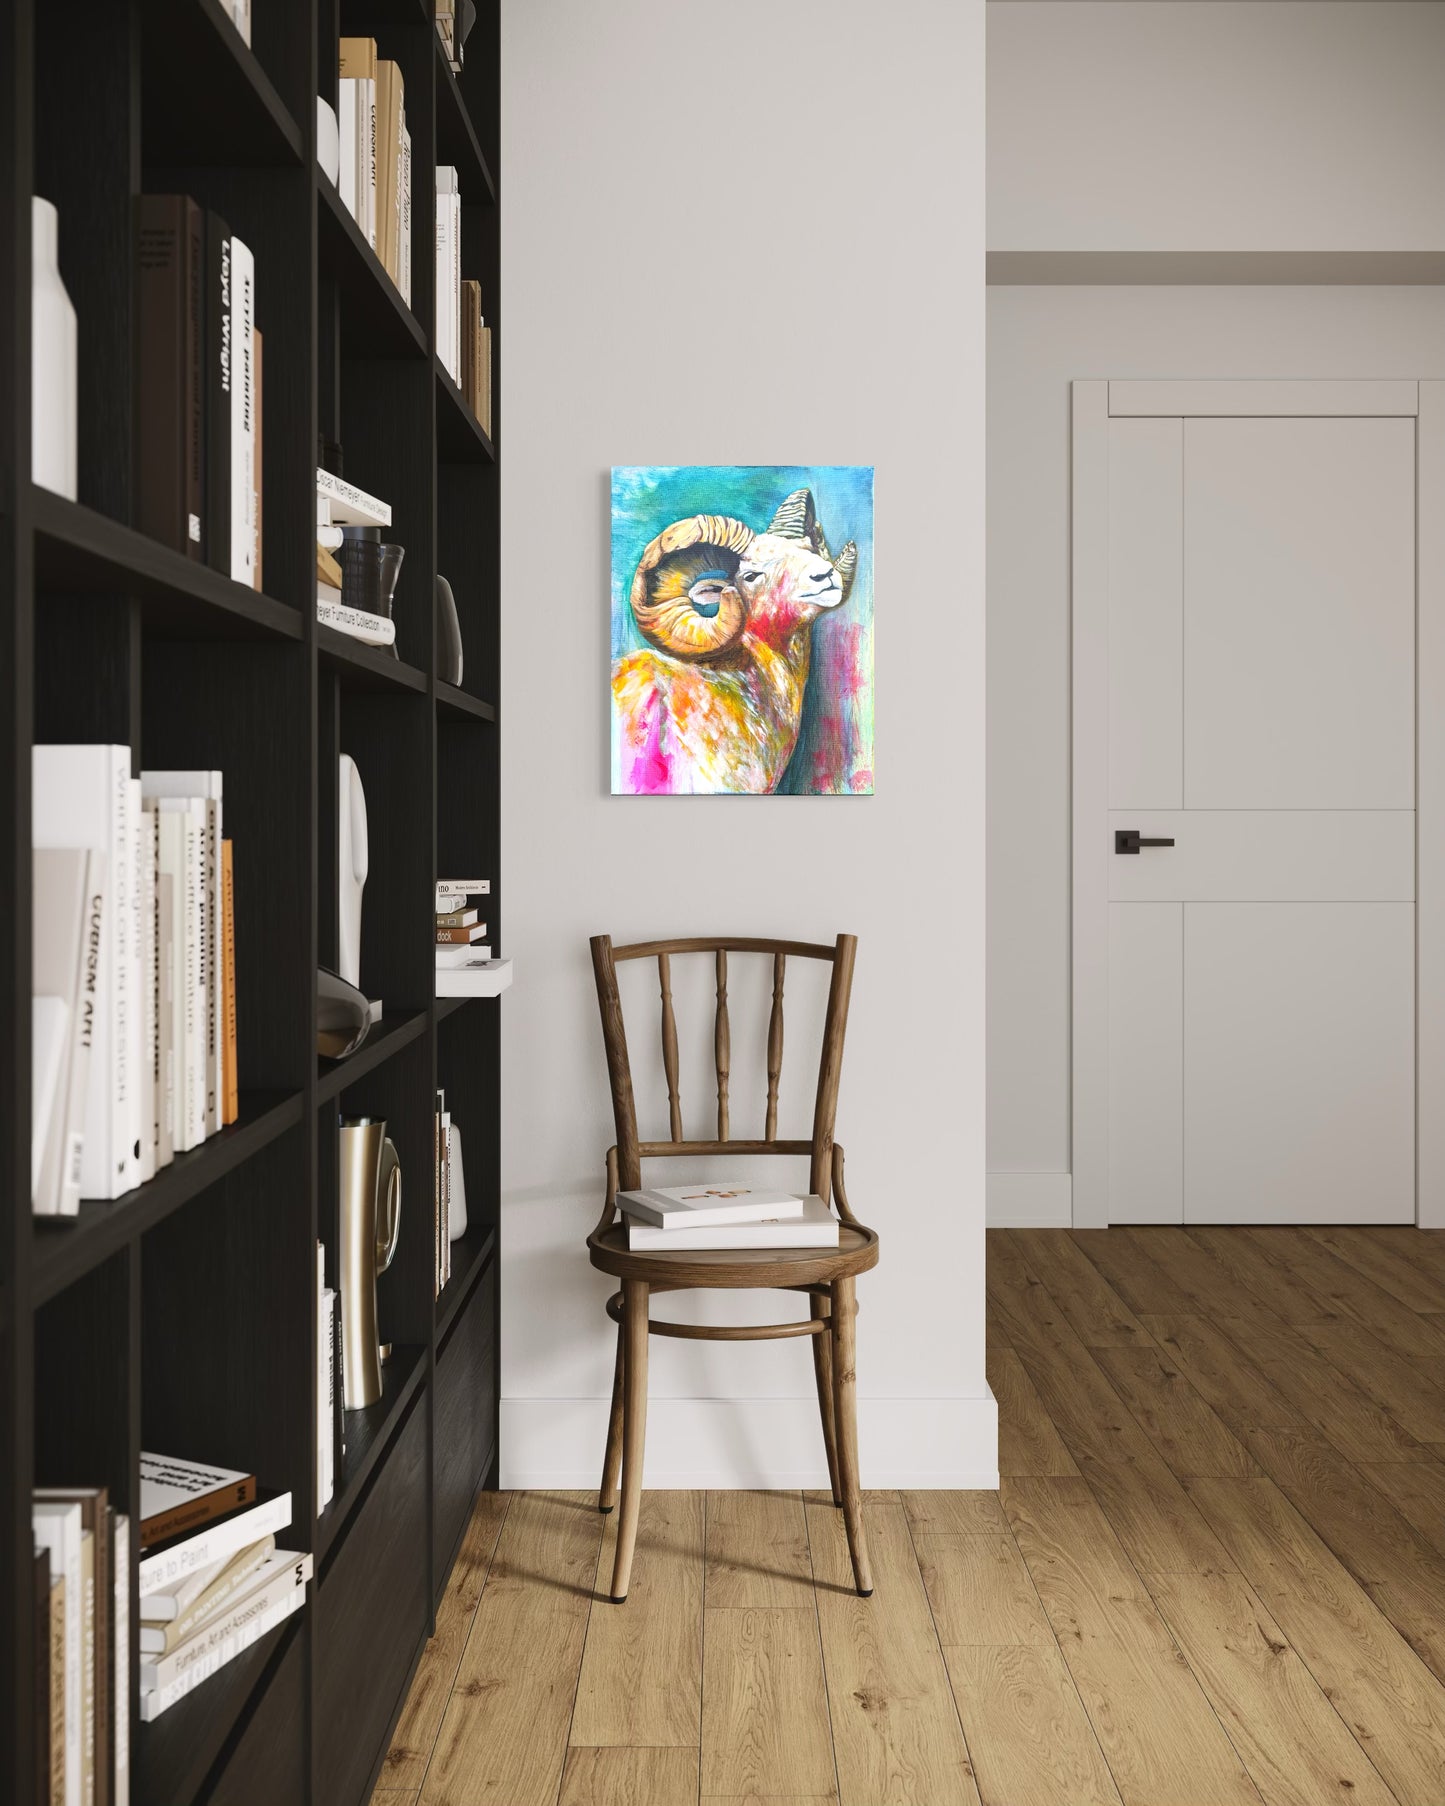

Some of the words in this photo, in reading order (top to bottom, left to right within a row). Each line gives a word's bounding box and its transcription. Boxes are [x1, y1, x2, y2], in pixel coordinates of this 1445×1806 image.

[403, 142, 411, 187] Renzo
[403, 189, 411, 231] Piano
[221, 239, 230, 307] Lloyd
[243, 275, 251, 340] Acrylic
[221, 313, 230, 392] Wright
[243, 348, 251, 433] painting
[332, 606, 356, 626] Furniture
[356, 613, 380, 632] Collection
[117, 767, 127, 852] WHITE
[187, 831, 195, 865] the
[117, 862, 127, 958] COLOR
[86, 894, 103, 993] CUBISM
[117, 966, 127, 992] IN
[187, 943, 195, 1035] furniture
[82, 1000, 94, 1048] ART
[117, 1000, 127, 1104] DESIGN
[166, 1559, 178, 1574] to
[181, 1544, 208, 1567] Paint
